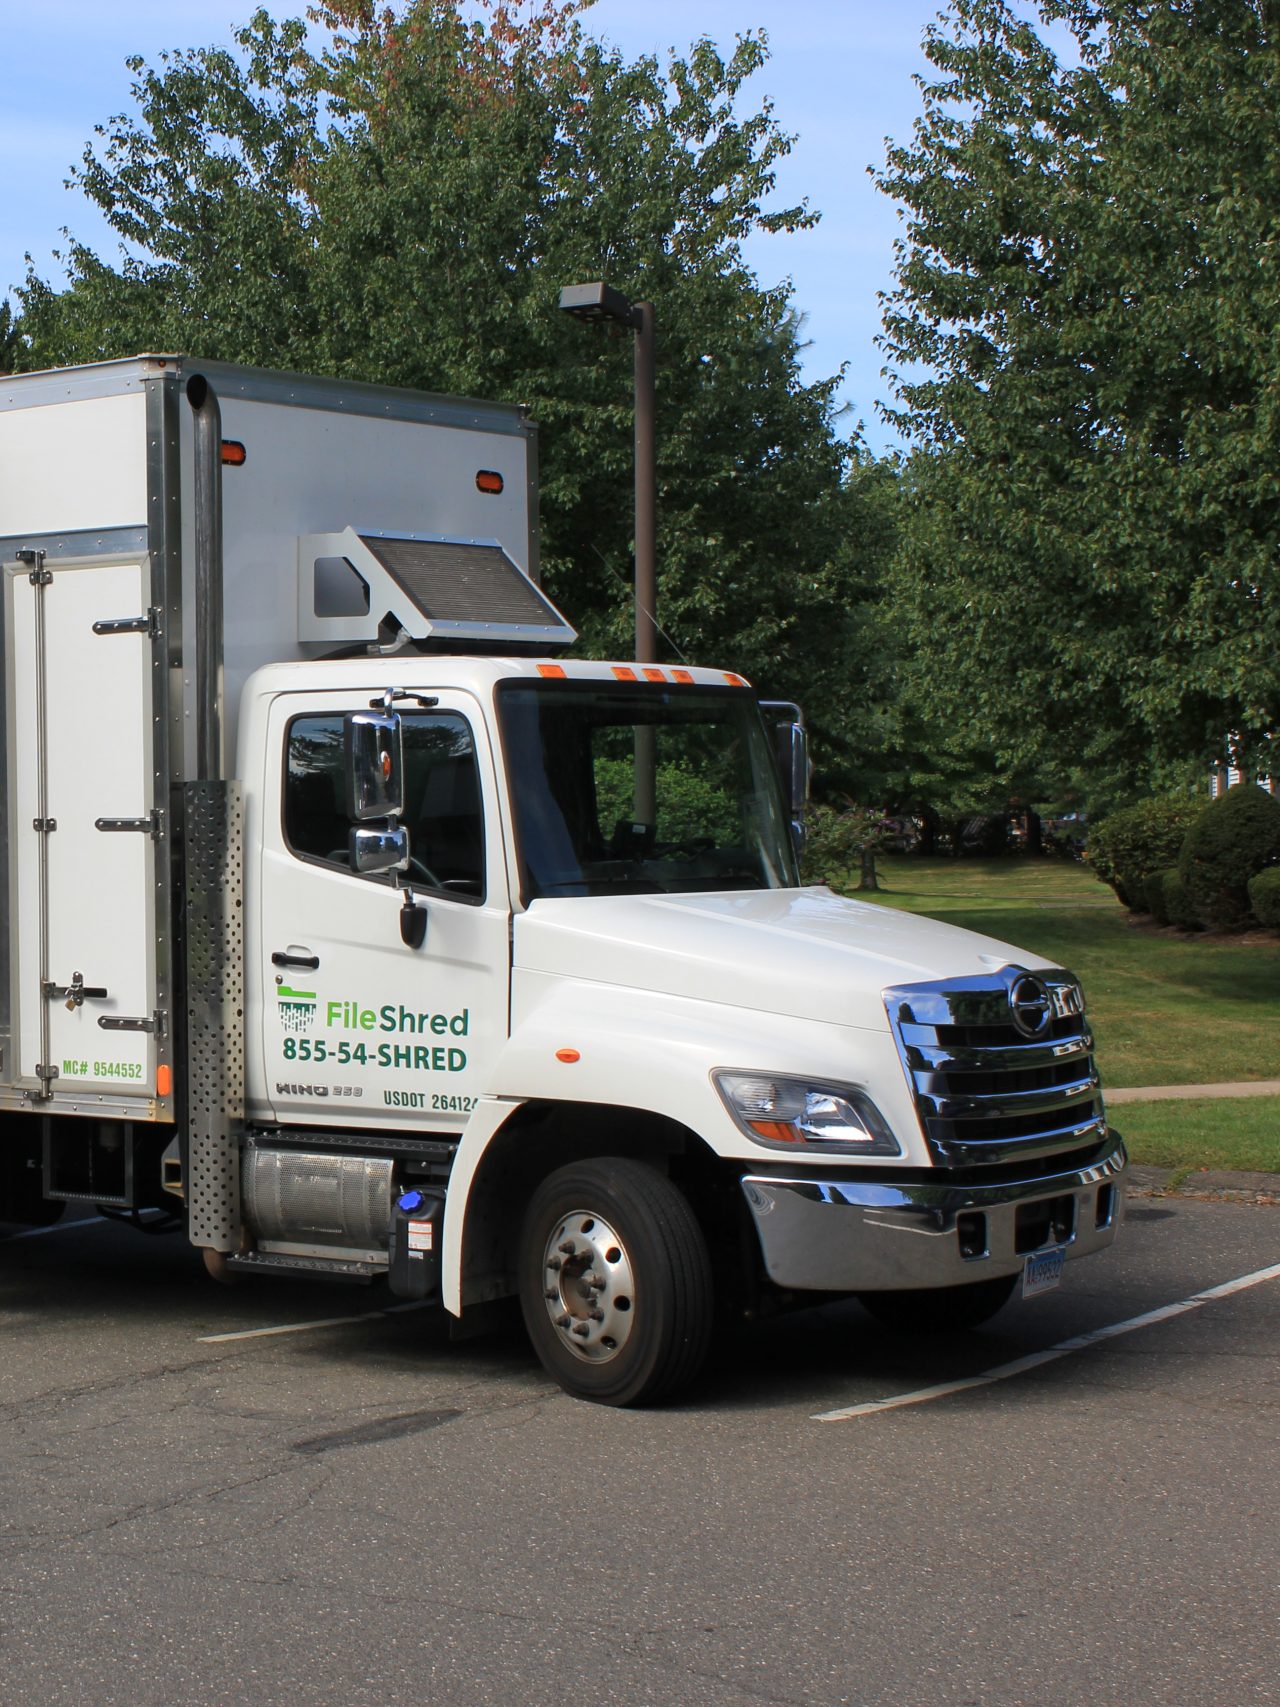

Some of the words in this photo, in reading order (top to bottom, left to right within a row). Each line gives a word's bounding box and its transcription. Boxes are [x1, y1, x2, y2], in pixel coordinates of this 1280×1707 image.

[327, 1001, 469, 1036] FileShred
[282, 1037, 467, 1071] 855-54-SHRED
[63, 1060, 88, 1075] MC#
[94, 1061, 142, 1078] 9544552
[276, 1083, 328, 1096] HINO
[384, 1090, 426, 1108] USDOT
